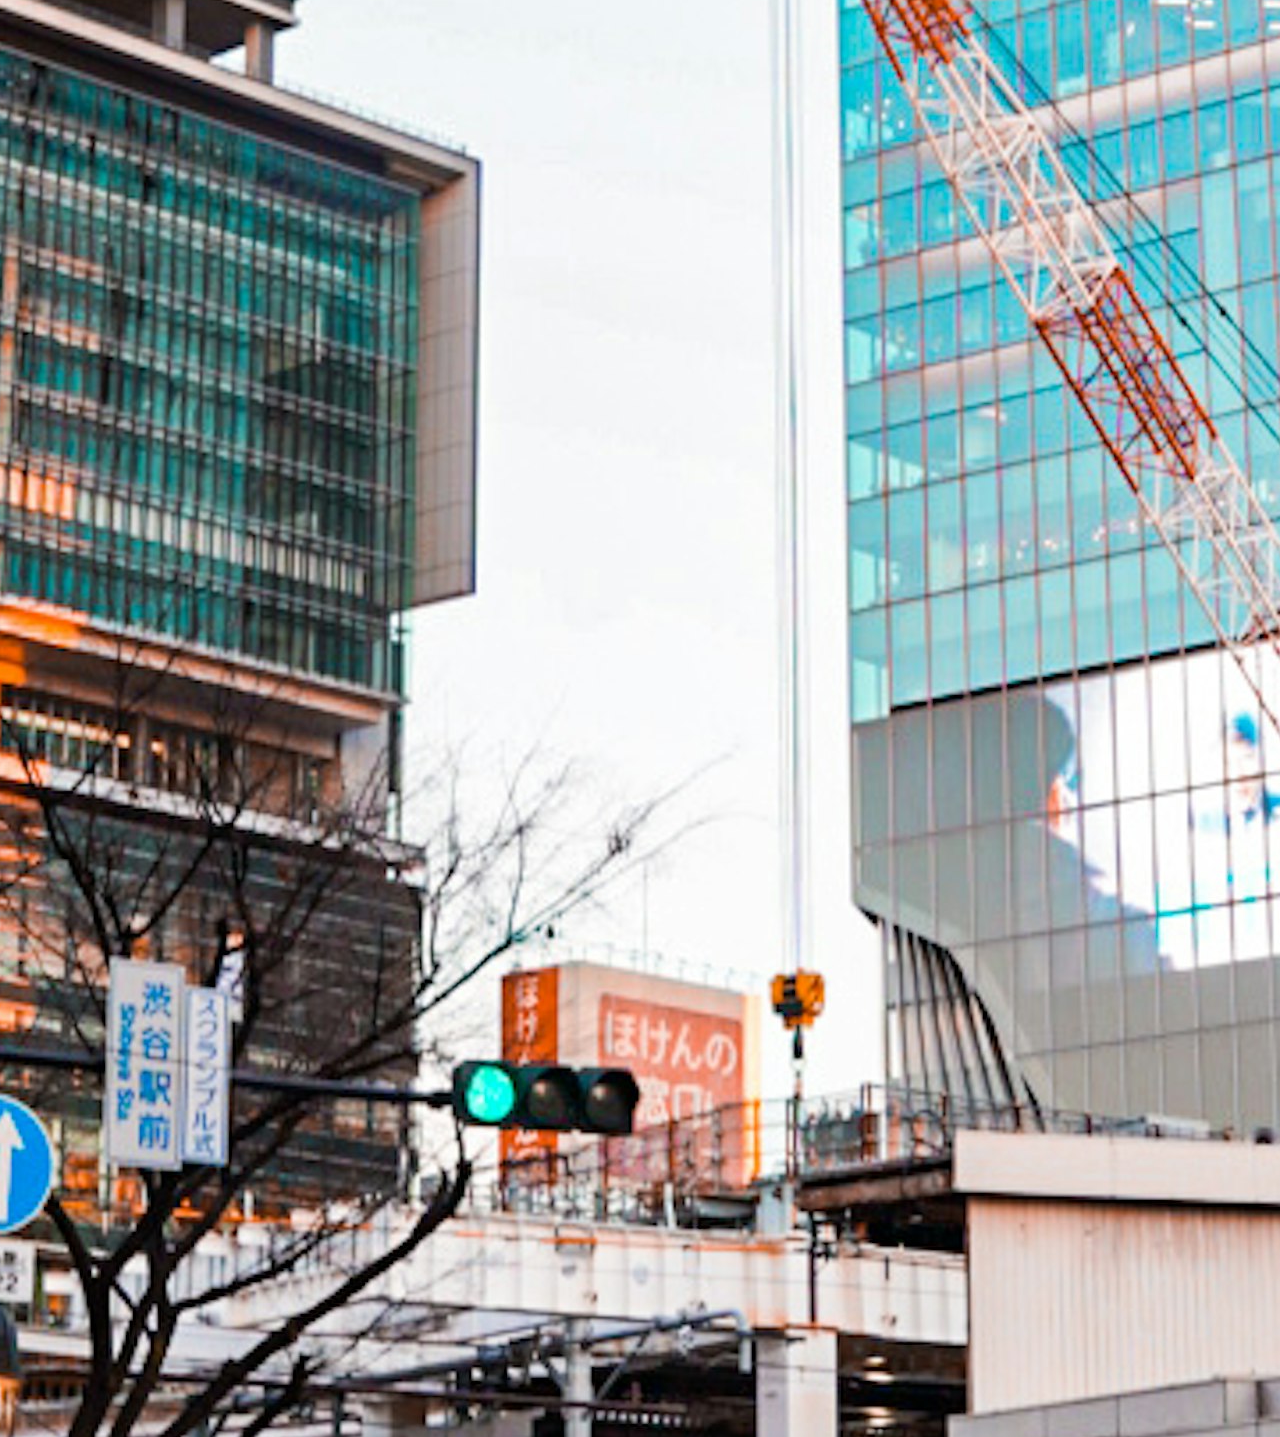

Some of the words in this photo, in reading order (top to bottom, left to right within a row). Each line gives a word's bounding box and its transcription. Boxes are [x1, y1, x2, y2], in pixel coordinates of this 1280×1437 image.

[137, 981, 172, 1152] 渋谷駅前
[603, 1011, 738, 1076] ほけんの
